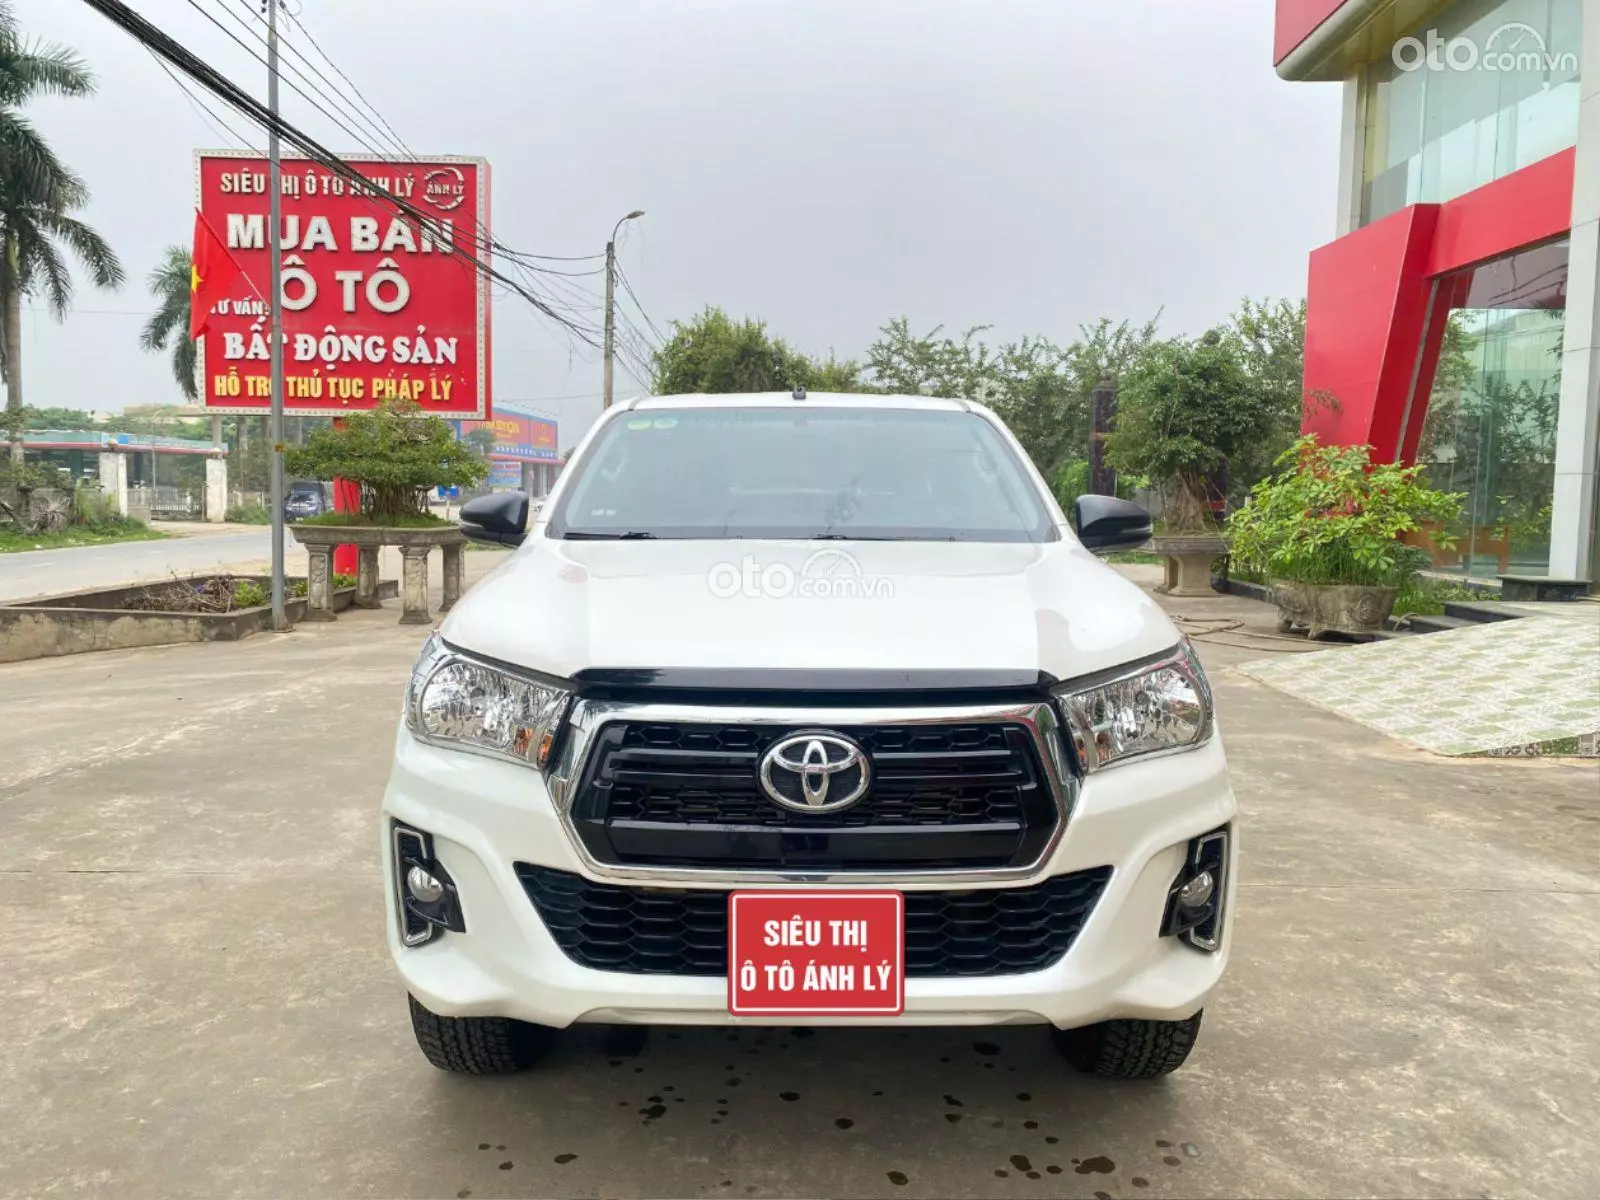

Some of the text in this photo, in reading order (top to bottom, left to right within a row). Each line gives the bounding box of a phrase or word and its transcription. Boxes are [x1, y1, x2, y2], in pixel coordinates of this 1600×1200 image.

[220, 168, 265, 193] SIÊU
[279, 174, 300, 199] HỊ
[305, 169, 317, 195] Ô
[395, 173, 414, 197] LÝ
[226, 213, 338, 251] MUA
[280, 254, 410, 313] Ô TÔ
[211, 299, 230, 314] Ư
[293, 325, 387, 370] ĐỘNG
[392, 325, 458, 364] SẢN
[214, 366, 452, 404] HỖ TR THỦ TỤC PHÁP LÝ
[764, 915, 867, 952] SIÊU THỊ
[741, 960, 892, 991] Ô TÔ ÁNH LÝ
